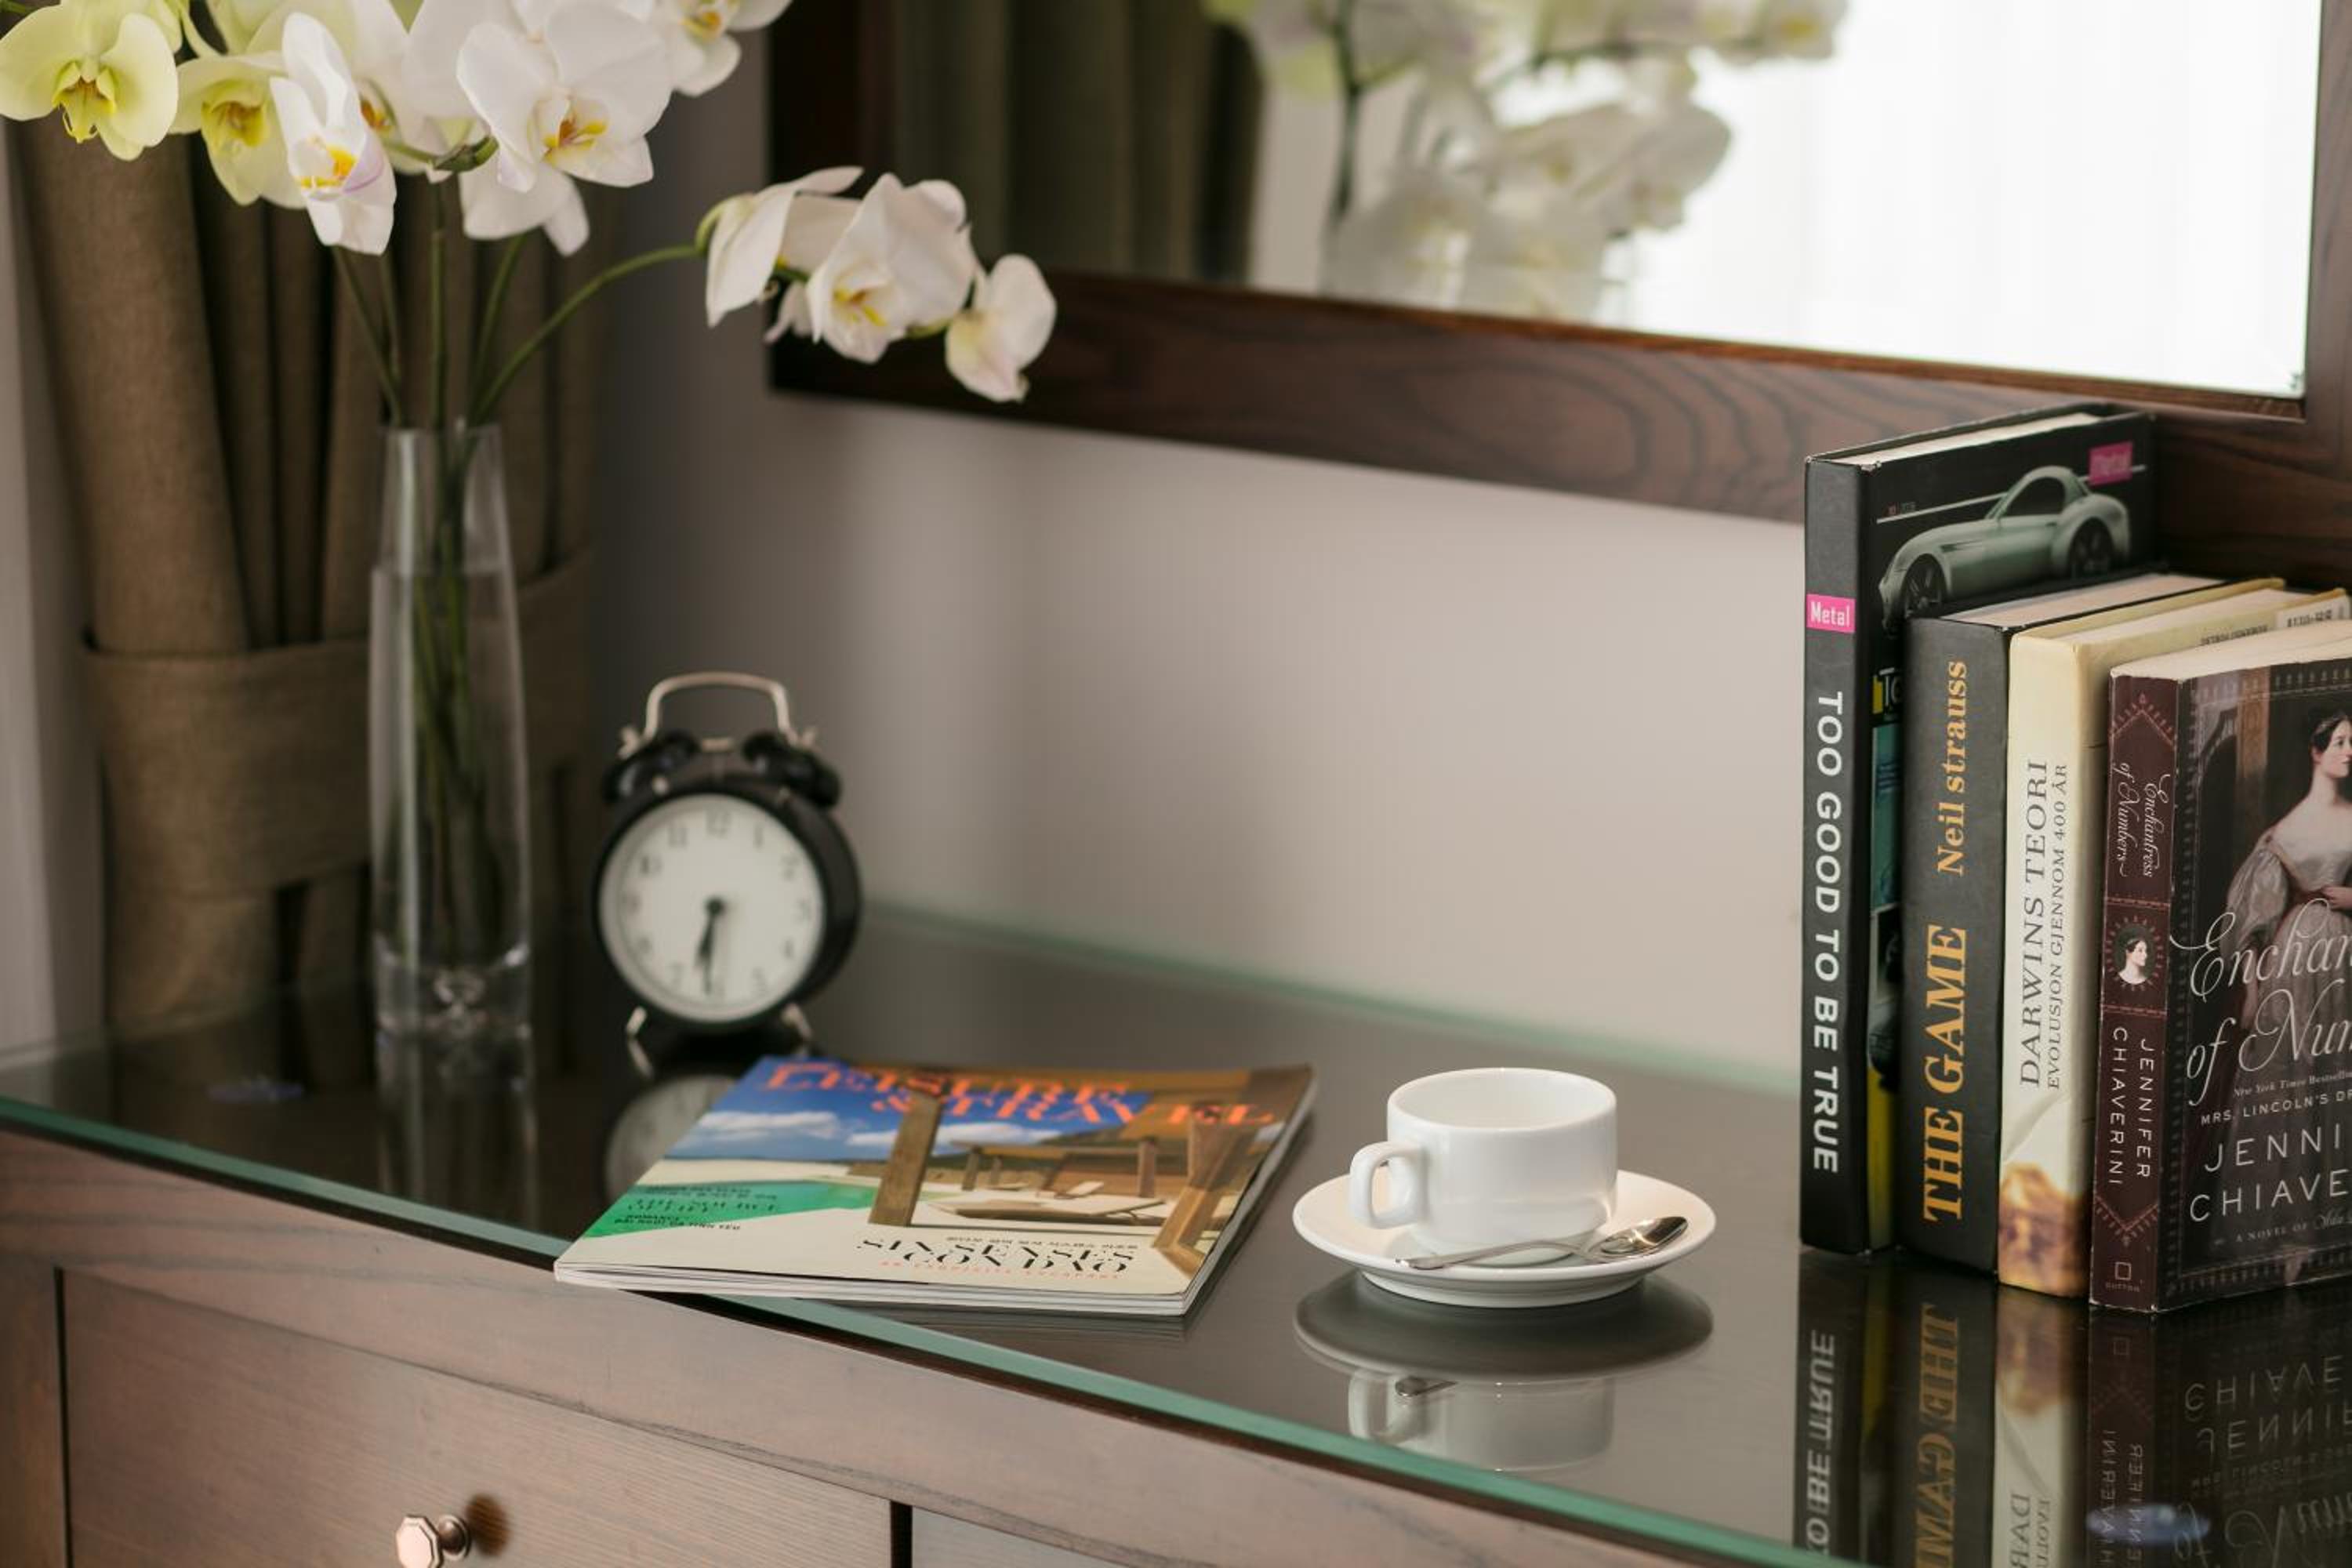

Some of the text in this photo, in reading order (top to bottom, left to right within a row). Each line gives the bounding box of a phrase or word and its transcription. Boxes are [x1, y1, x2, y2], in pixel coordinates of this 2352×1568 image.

[1810, 601, 1850, 627] Metal
[2112, 761, 2140, 877] of Numbers
[2143, 773, 2172, 878] Enchantress
[1813, 691, 1843, 1173] TOO GOOD TO BE TRUE
[1923, 661, 1968, 1221] THE GAME Neil strauss
[2020, 759, 2048, 1088] DARWINS TEORI
[2047, 763, 2068, 1091] EVOLUSJON GJENNOM 400 ÅR
[2108, 1025, 2129, 1185] CHIAVERINI
[2136, 1038, 2155, 1178] JENNIFER
[2187, 1017, 2237, 1106] of
[2243, 1093, 2330, 1118] LINCOLN'S
[2189, 1168, 2350, 1223] CHIAVE
[2247, 1225, 2287, 1241] NOVEL
